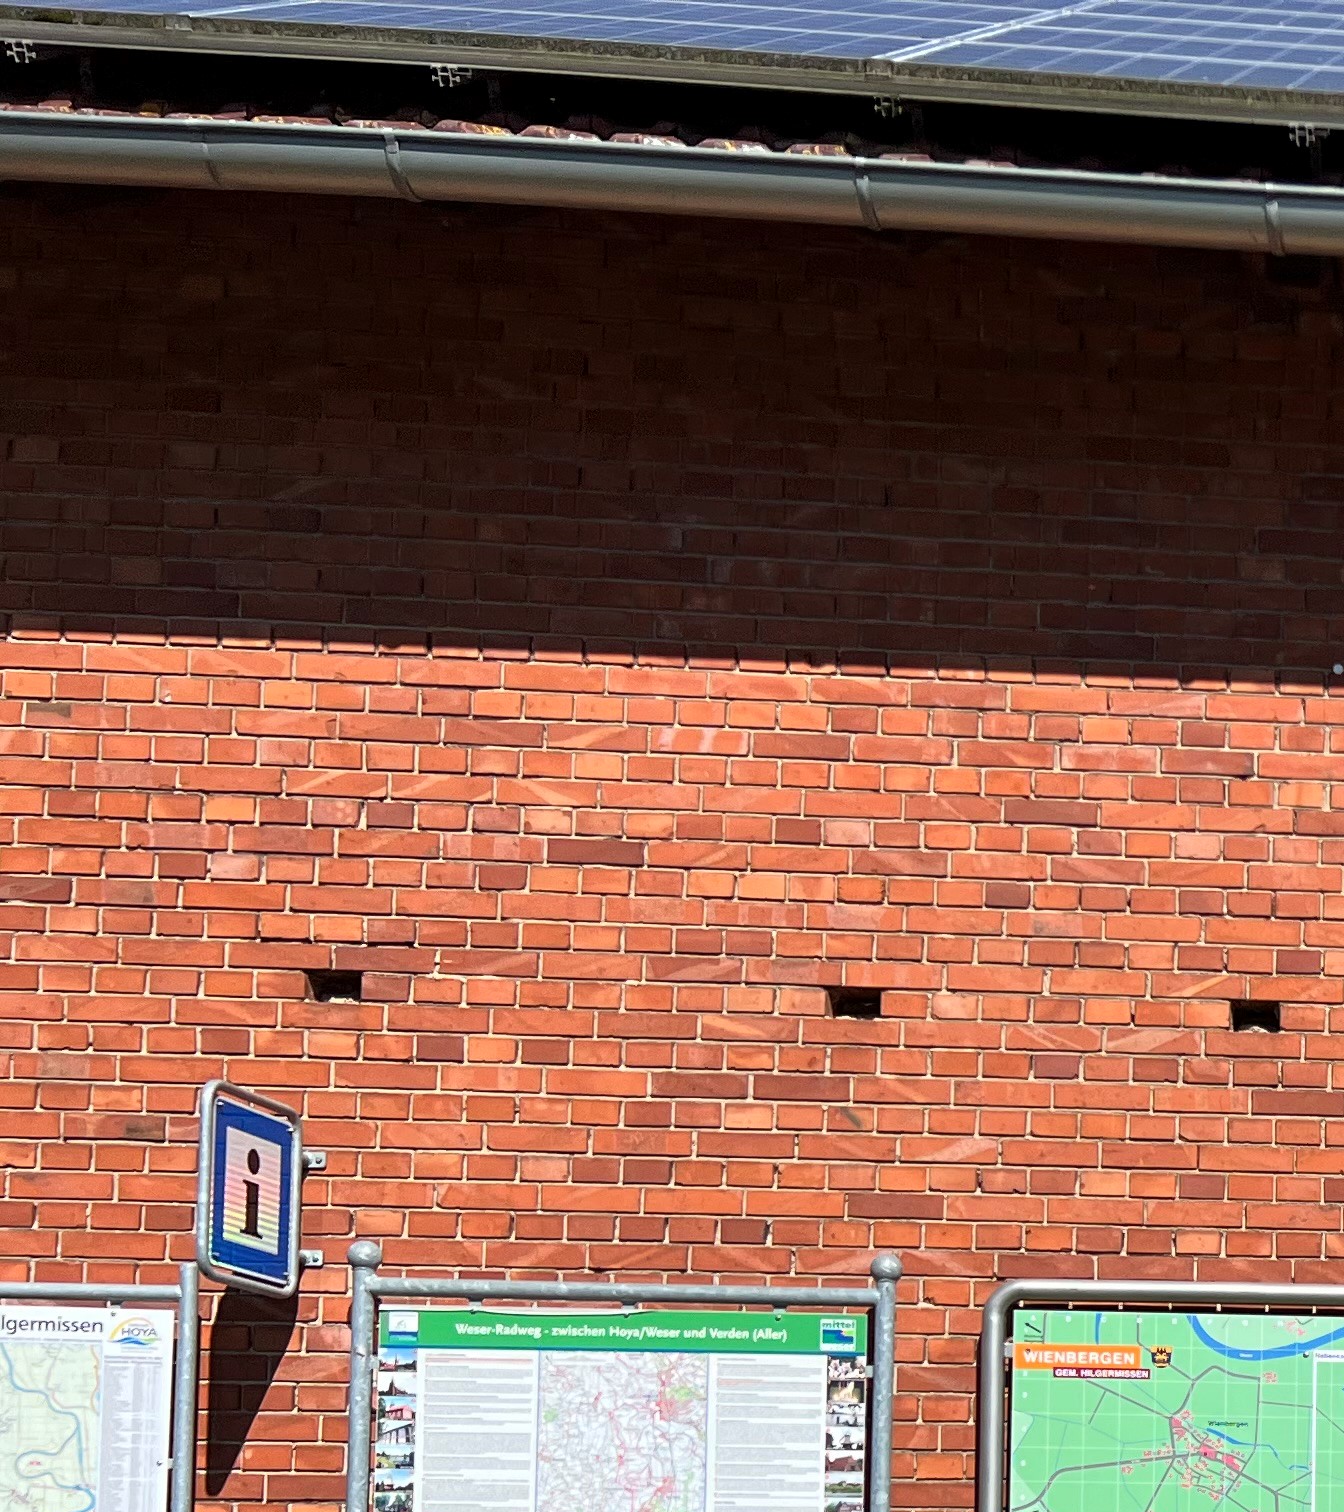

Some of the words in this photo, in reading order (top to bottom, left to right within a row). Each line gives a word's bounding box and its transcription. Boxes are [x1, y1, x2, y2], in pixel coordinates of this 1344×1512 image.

[0, 1315, 103, 1334] lgermissen
[121, 1327, 158, 1337] HOYA
[455, 1323, 542, 1339] Weser-Radweg
[551, 1325, 606, 1337] zwischen
[609, 1325, 680, 1341] Hoya/Weser
[684, 1327, 707, 1339] und
[709, 1327, 749, 1340] Verden
[753, 1327, 787, 1343] (Aller)
[1023, 1350, 1135, 1365] WIENBERGEN
[1081, 1369, 1149, 1378] HILGERMISSEN
